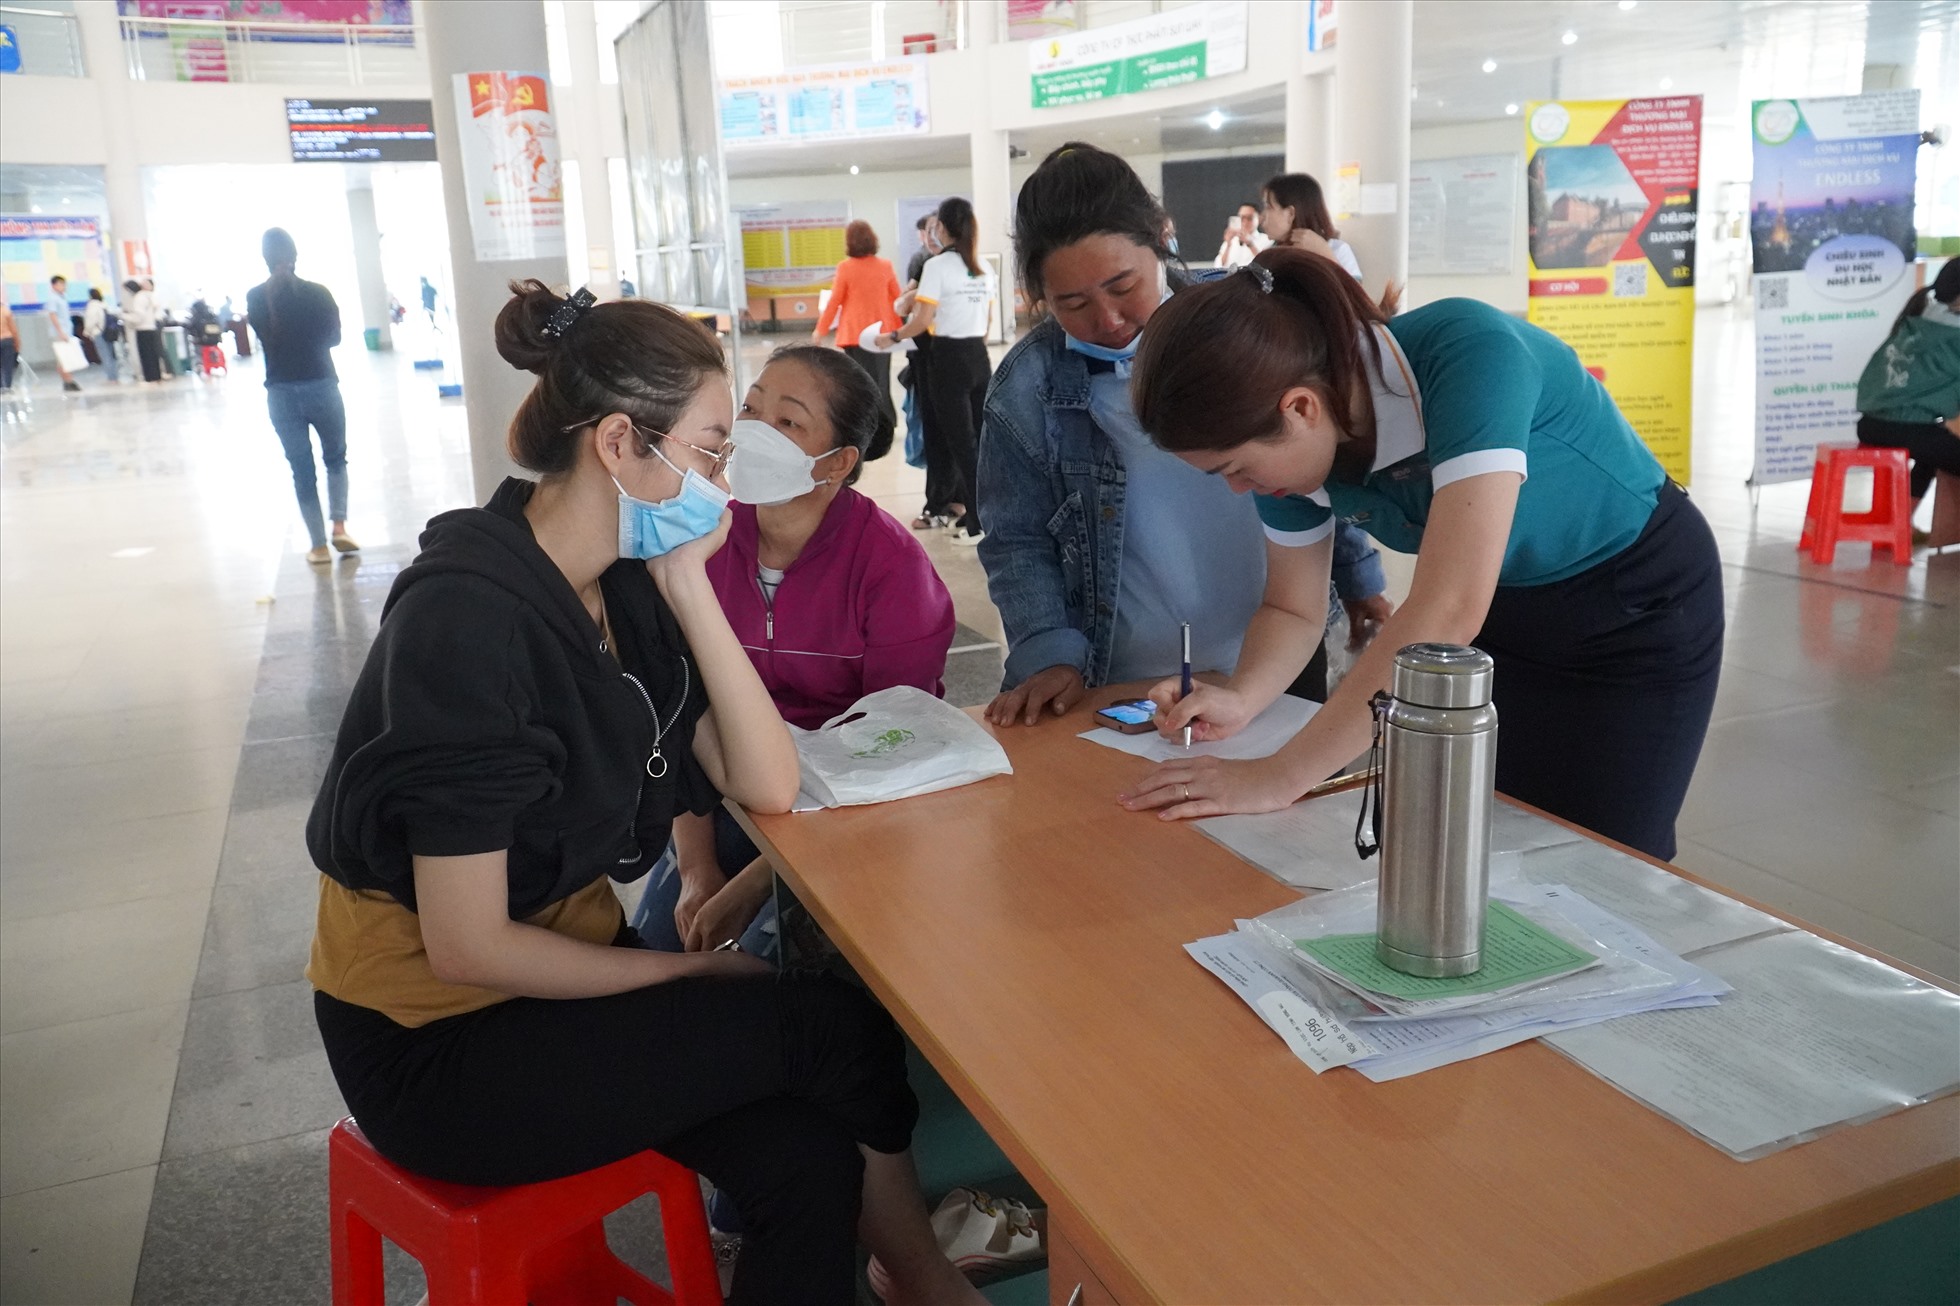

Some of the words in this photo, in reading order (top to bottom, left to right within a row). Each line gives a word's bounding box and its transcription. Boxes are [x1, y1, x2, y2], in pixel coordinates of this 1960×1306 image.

[1658, 121, 1694, 131] ENDLESS
[1815, 169, 1881, 186] ENDLESS
[1825, 250, 1858, 262] CHIÊU
[1859, 249, 1884, 260] SINH
[1835, 263, 1850, 273] DU
[1853, 262, 1874, 273] HỌC
[1564, 280, 1580, 292] HỘI
[1827, 277, 1857, 287] NHẬT
[1859, 274, 1882, 284] BẢN
[1781, 313, 1814, 324] TUYỂN
[1818, 312, 1843, 322] SINH
[1773, 383, 1806, 395] QUYỀN
[1810, 383, 1827, 394] LỢI
[1304, 1018, 1327, 1042] 1096
[1330, 1024, 1341, 1034] sơ
[1346, 1042, 1358, 1055] Nộp
